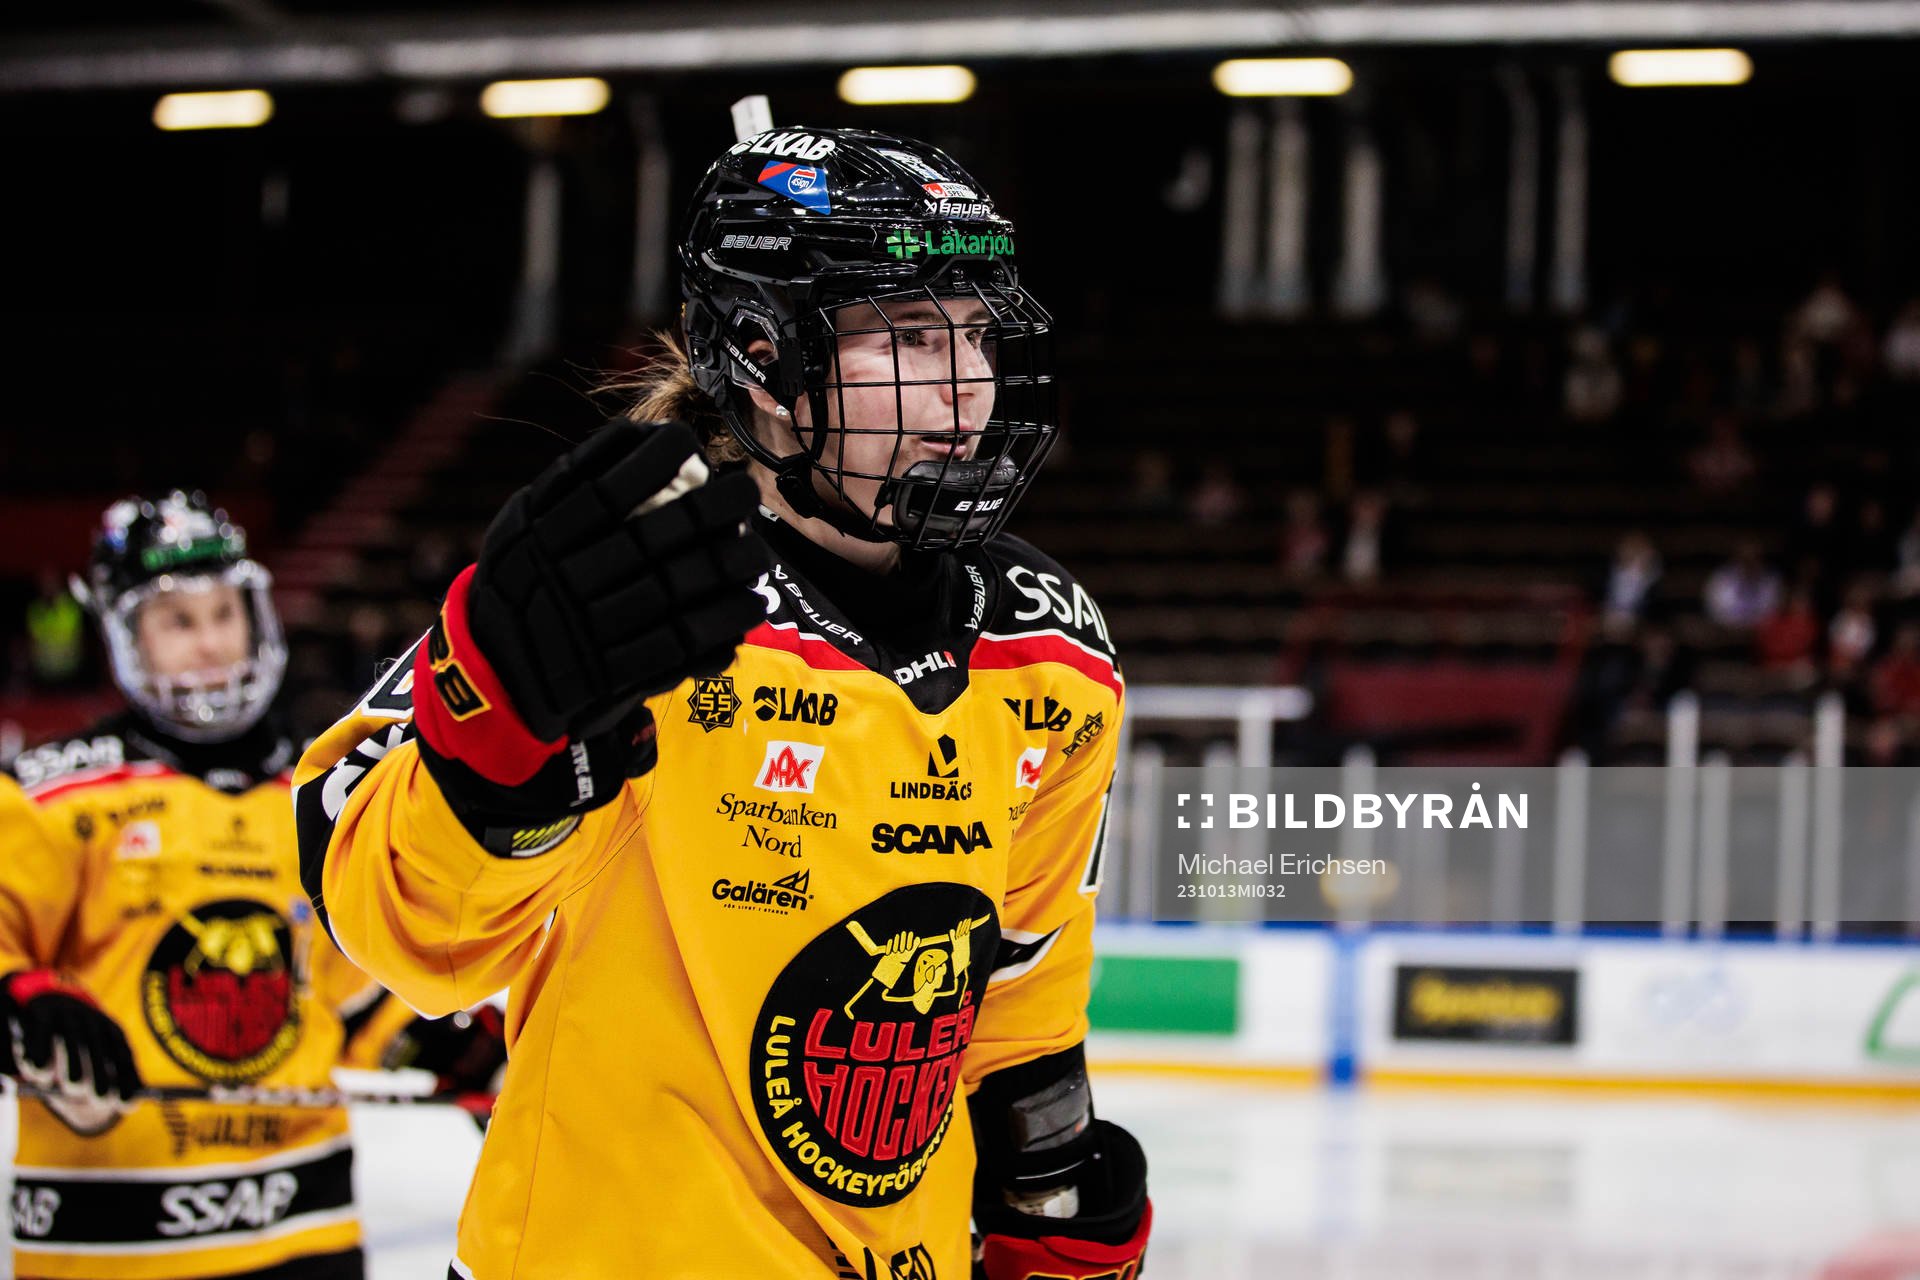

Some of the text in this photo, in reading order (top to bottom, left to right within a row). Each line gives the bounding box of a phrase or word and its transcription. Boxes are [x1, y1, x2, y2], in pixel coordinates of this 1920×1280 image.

[749, 132, 836, 160] LKAB
[894, 650, 950, 686] DHL
[762, 745, 814, 789] MAX
[716, 792, 838, 829] Sparbanken
[741, 824, 803, 858] Nord
[712, 878, 809, 911] Galären
[805, 990, 975, 1062] LULEÅ
[765, 1015, 802, 1119] LULEÅ
